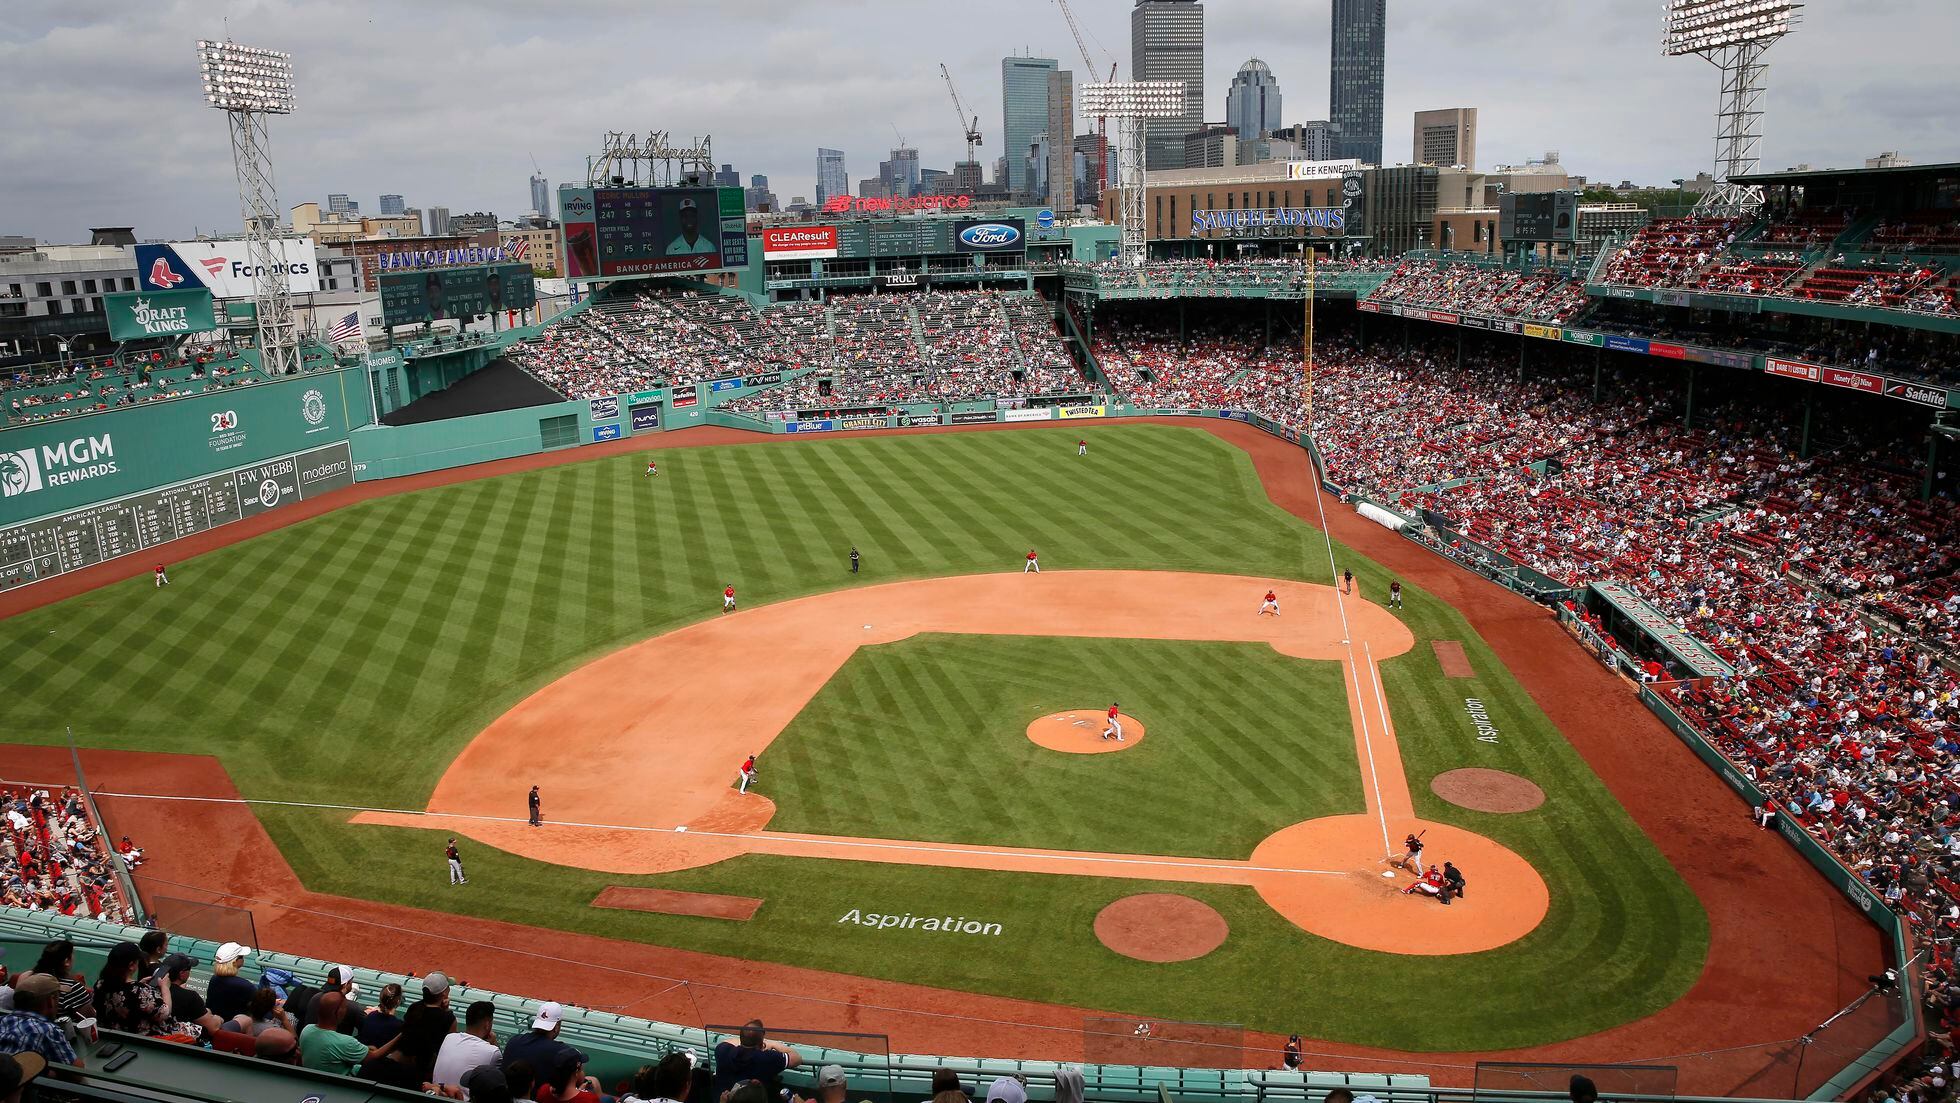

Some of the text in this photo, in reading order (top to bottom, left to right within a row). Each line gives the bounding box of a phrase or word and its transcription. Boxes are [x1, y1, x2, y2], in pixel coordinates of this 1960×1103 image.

[1302, 164, 1354, 176] LEE KENNEDY
[564, 202, 592, 211] IRVING
[856, 193, 969, 212] new balance
[1193, 206, 1343, 232] SAMUEL ADAMS
[770, 231, 830, 242] CLEAResult
[972, 226, 1008, 243] Ford
[380, 247, 506, 268] BANK OF AMERICA
[616, 264, 640, 273] BANK
[654, 262, 692, 270] AMERICA
[885, 274, 917, 284] TRULY
[136, 306, 186, 325] DRAFT
[1404, 308, 1428, 319] CRAFTSMAN
[144, 318, 189, 334] KINGS
[1571, 332, 1594, 341] HORNITOS
[369, 356, 396, 367] ABIOMED
[1776, 362, 1787, 371] DARE
[1793, 366, 1808, 375] LISTEN
[1834, 374, 1872, 387] Ninety Nine
[1905, 386, 1945, 405] Safelite
[634, 414, 656, 422] nuna
[1065, 408, 1088, 417] TWISTED
[211, 410, 238, 432] 20
[797, 421, 822, 431] jetBlue
[843, 418, 887, 429] GRANITE CITY
[911, 416, 938, 424] wasabi
[209, 434, 246, 447] FOUNDATION
[42, 433, 114, 470] MGM
[48, 461, 117, 487] REWARDS
[260, 460, 293, 478] WEBB
[302, 460, 347, 480] moderna
[161, 480, 210, 497] NATIONAL LEAGUE
[244, 496, 258, 506] Since
[281, 486, 294, 495] 1866
[62, 503, 121, 523] AMERICAN LEAGUE
[7, 568, 19, 576] OUT
[1464, 698, 1499, 744] Aspiration
[838, 908, 1002, 936] Aspiration
